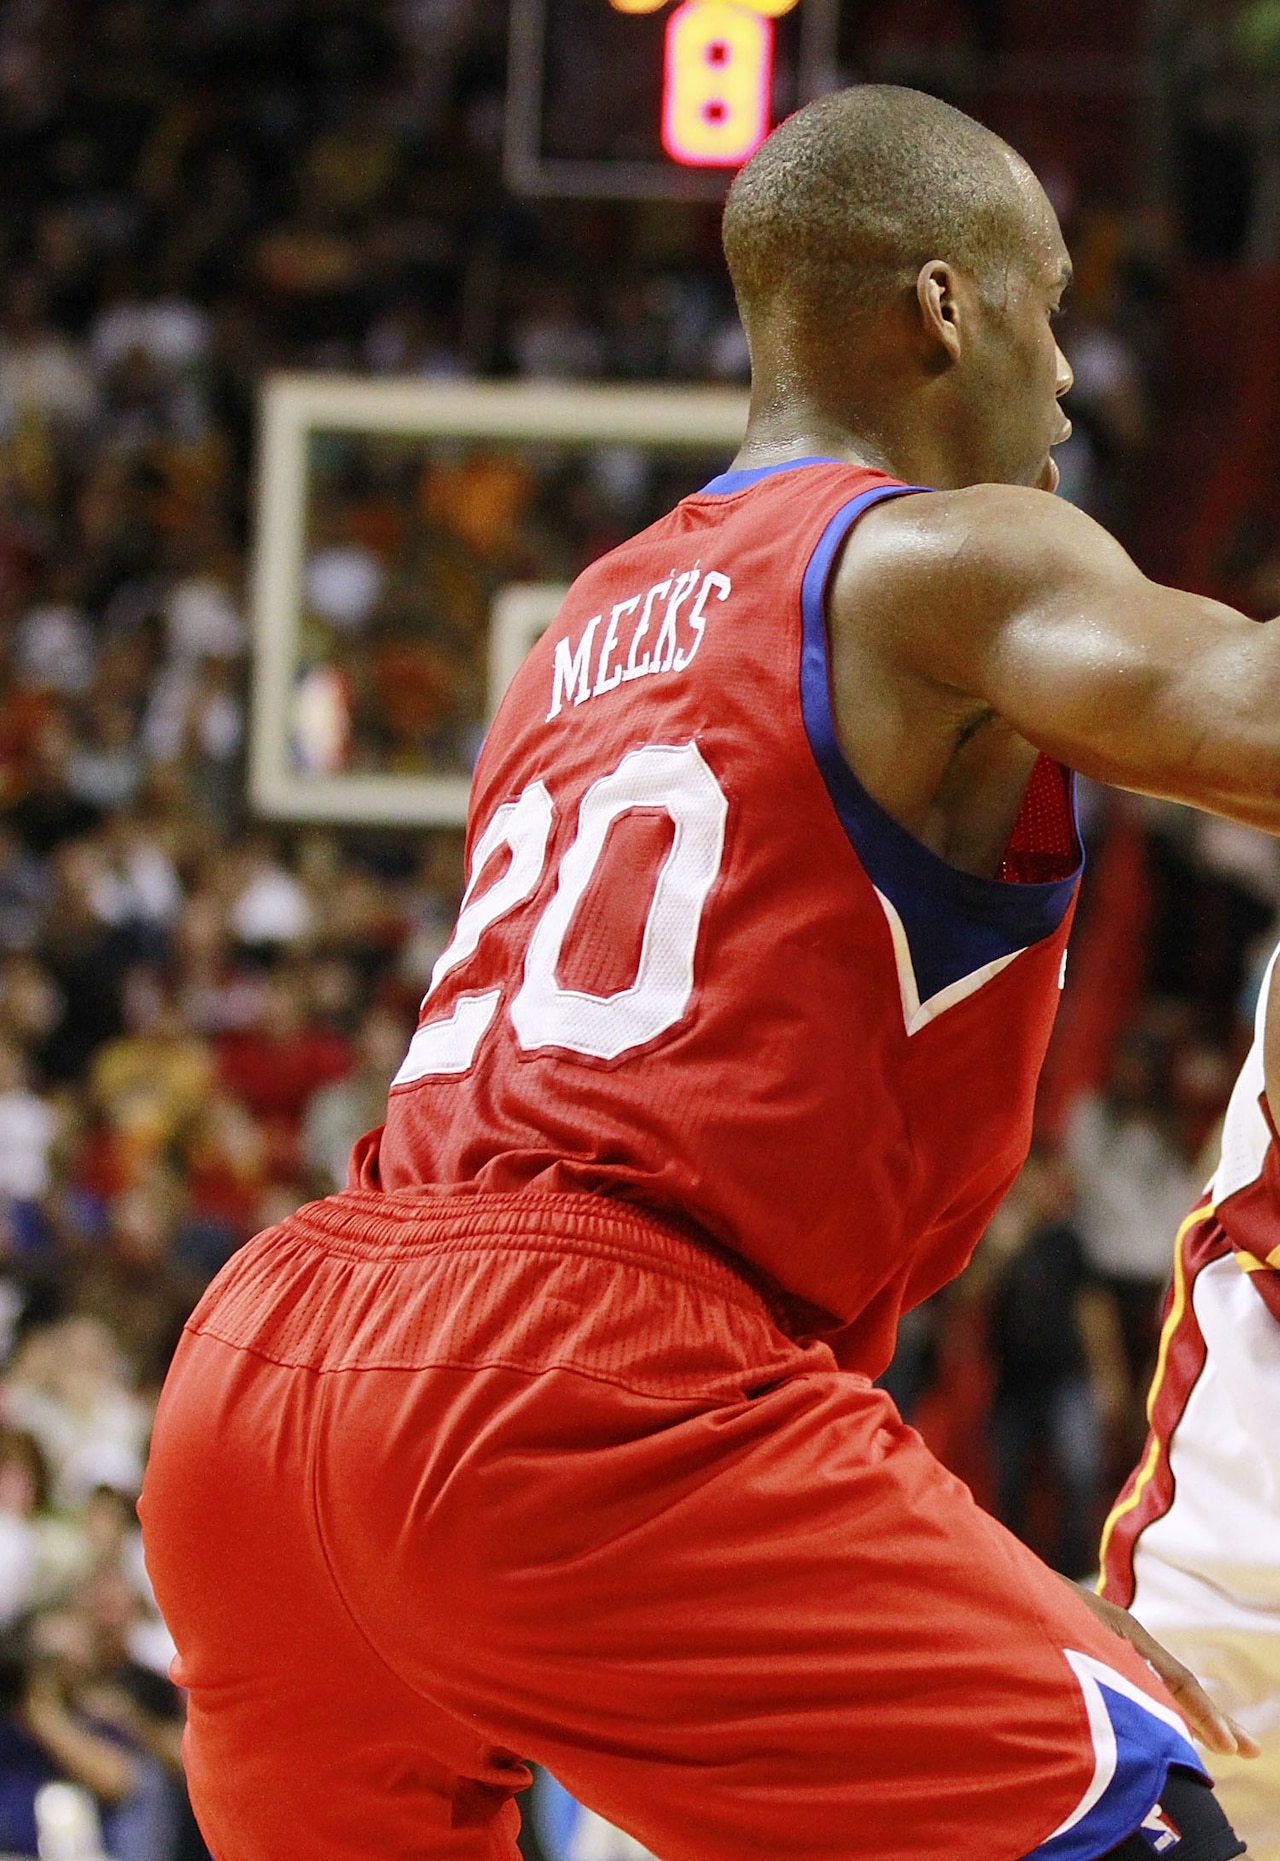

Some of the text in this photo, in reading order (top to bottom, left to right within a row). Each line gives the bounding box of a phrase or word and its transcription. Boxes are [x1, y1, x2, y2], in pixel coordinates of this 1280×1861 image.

[661, 0, 774, 168] 8
[545, 560, 731, 723] MEEKS
[390, 740, 729, 1087] 20
